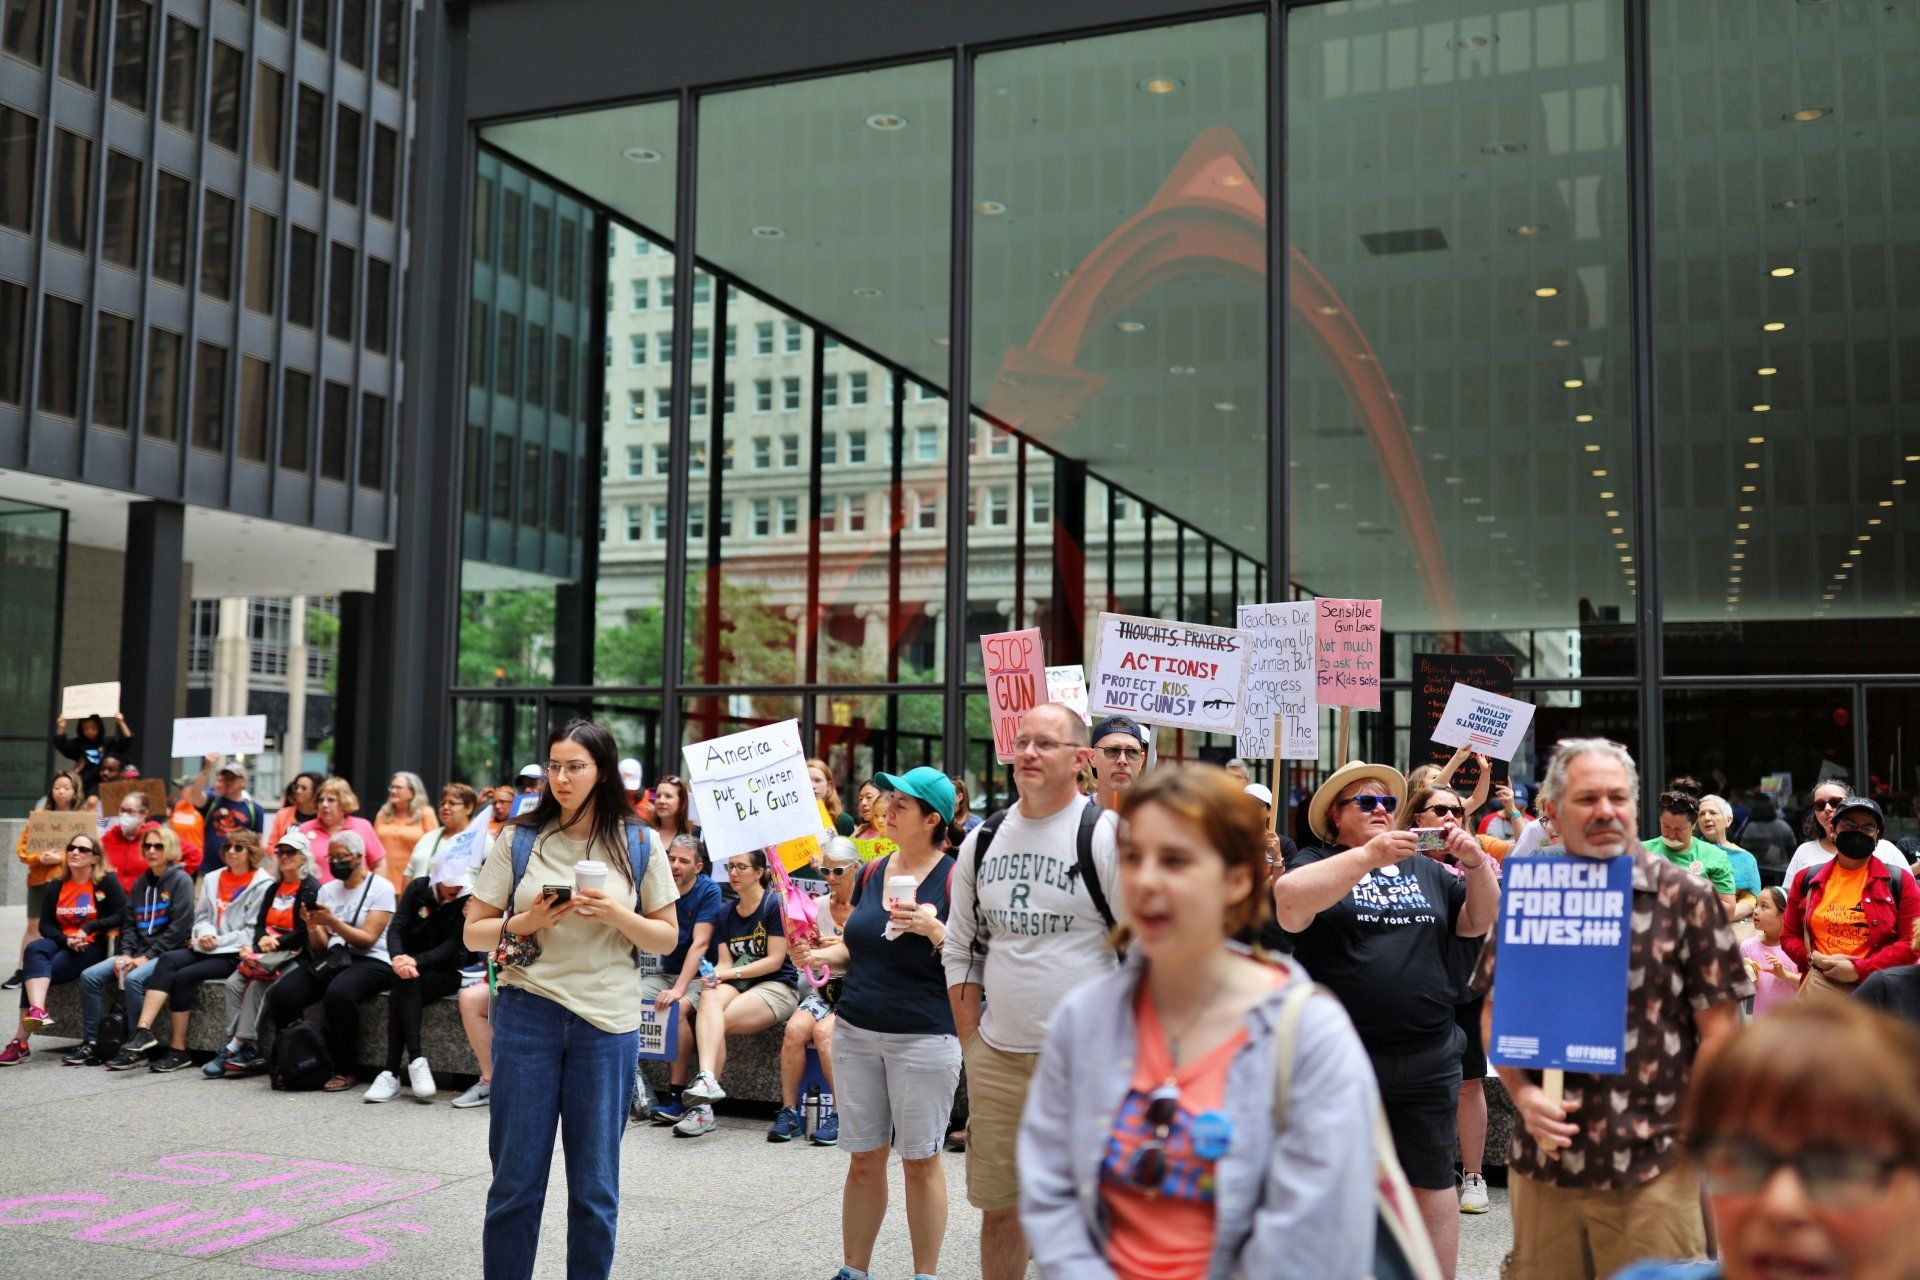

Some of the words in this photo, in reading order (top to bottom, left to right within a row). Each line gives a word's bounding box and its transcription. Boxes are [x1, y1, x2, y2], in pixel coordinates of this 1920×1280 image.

[1238, 608, 1287, 628] Teachers
[1292, 609, 1310, 624] Die
[1322, 601, 1372, 618] Sensible
[1335, 620, 1353, 632] Gun
[1356, 619, 1375, 632] Laws
[1185, 629, 1236, 652] PRAYERS
[1300, 629, 1313, 654] Up
[1320, 637, 1336, 652] Not
[1344, 638, 1373, 653] much
[987, 638, 1032, 670] STOP
[1291, 652, 1313, 671] But
[1320, 656, 1330, 668] to
[1333, 657, 1352, 668] ask
[1357, 655, 1374, 670] for
[1120, 652, 1219, 680] ACTIONS!
[1102, 674, 1156, 692] PROTECT
[1247, 673, 1301, 699] Congress
[1317, 670, 1333, 686] For
[1336, 671, 1356, 689] Kids
[996, 674, 1035, 712] GUN
[1106, 690, 1138, 707] NOT
[1141, 693, 1196, 716] GUNS!
[1273, 694, 1306, 716] Stand
[1477, 705, 1511, 721] ACTION
[1255, 718, 1269, 737] To
[1286, 716, 1311, 738] The
[1455, 718, 1504, 737] STUDENTS
[1469, 712, 1508, 730] DEMAND
[706, 741, 771, 770] America
[748, 770, 794, 793] Children
[767, 791, 799, 810] Guns
[32, 823, 46, 832] ARE
[1508, 863, 1608, 889] MARCH
[1010, 883, 1030, 908] R
[1506, 890, 1561, 917] FOR
[1564, 891, 1624, 918] OUR
[1357, 914, 1379, 923] NEW
[1383, 916, 1411, 925] YORK
[1415, 915, 1435, 924] CITY
[1505, 919, 1583, 945] LIVES
